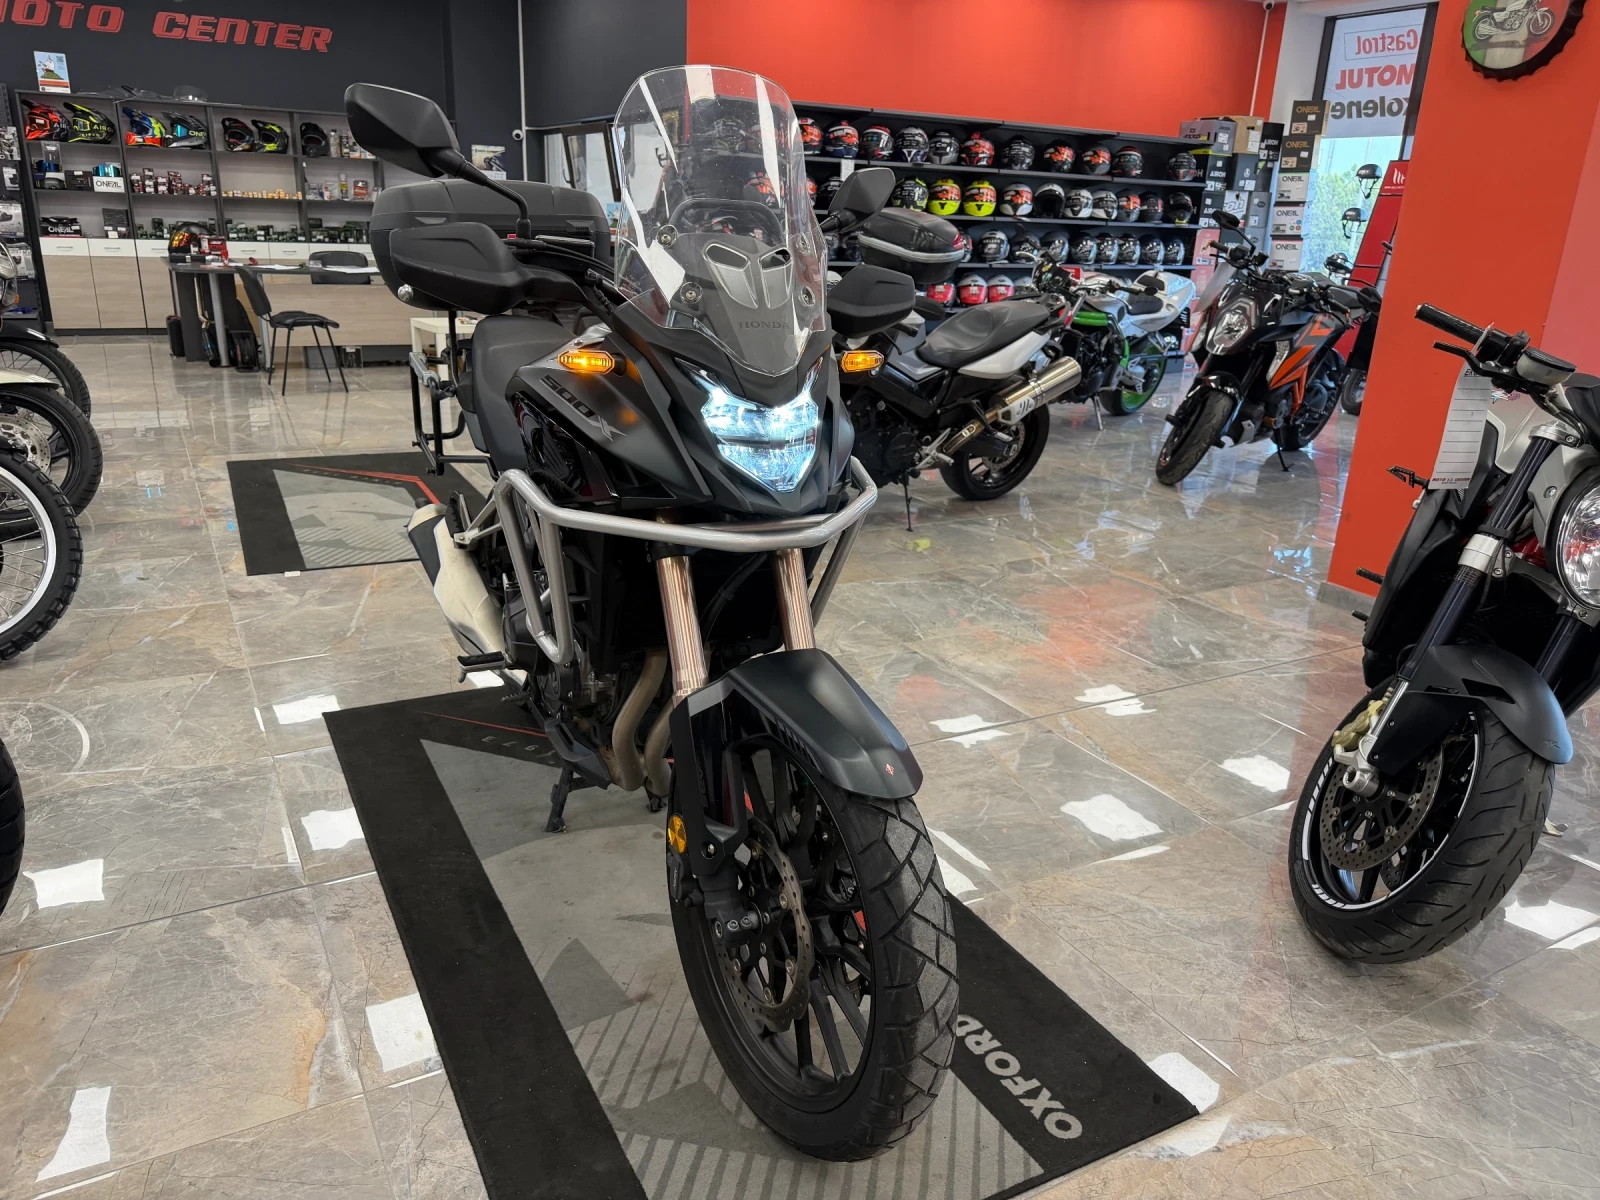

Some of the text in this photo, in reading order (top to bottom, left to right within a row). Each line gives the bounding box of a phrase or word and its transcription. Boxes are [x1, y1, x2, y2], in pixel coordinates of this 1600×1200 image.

[152, 11, 333, 52] CENTER
[739, 320, 790, 330] HONDA
[956, 1013, 1083, 1140] OXFORD
